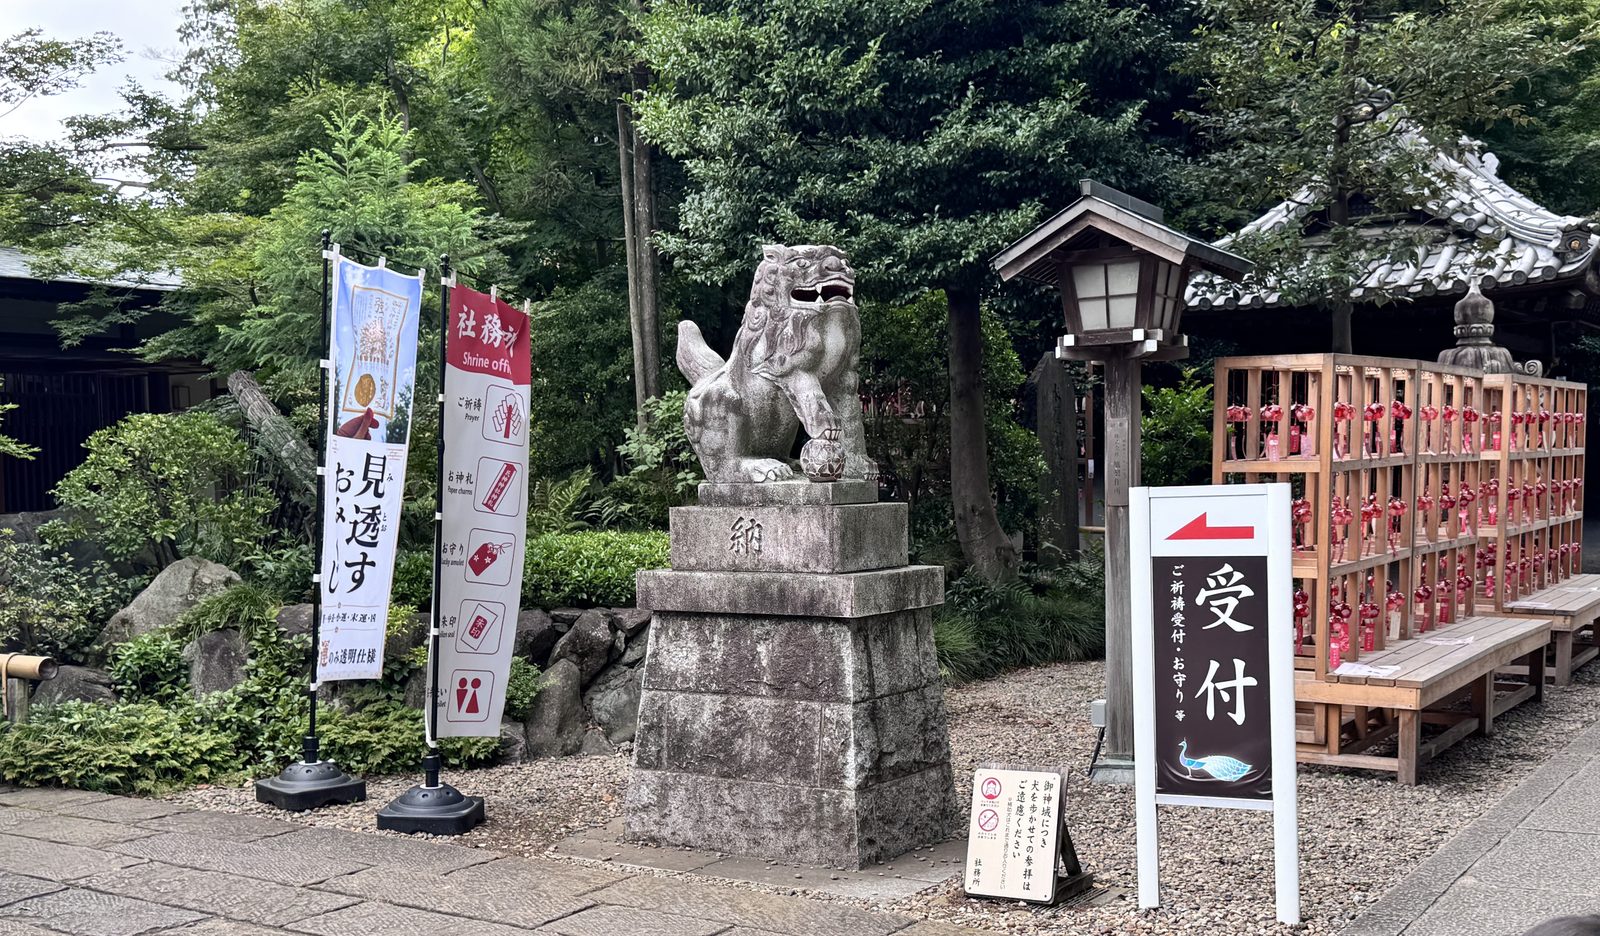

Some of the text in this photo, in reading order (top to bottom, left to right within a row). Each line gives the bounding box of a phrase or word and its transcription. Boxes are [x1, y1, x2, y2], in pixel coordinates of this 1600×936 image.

[463, 352, 512, 375] Shrine offi
[464, 414, 480, 422] Prayer
[448, 470, 474, 485] お神札
[458, 487, 473, 496] charms
[329, 462, 354, 594] おじ
[345, 452, 387, 593] 見透す
[729, 516, 763, 557] 納
[442, 542, 464, 556] お守り
[440, 615, 457, 629] 朱印
[471, 617, 485, 637] 朱印
[1195, 563, 1258, 726] 受付
[1012, 780, 1028, 858] ご遠慮ください
[1040, 780, 1054, 848] 御神域につき
[1022, 780, 1039, 891] 犬を歩かせての参拝は
[972, 858, 982, 886] 社務所
